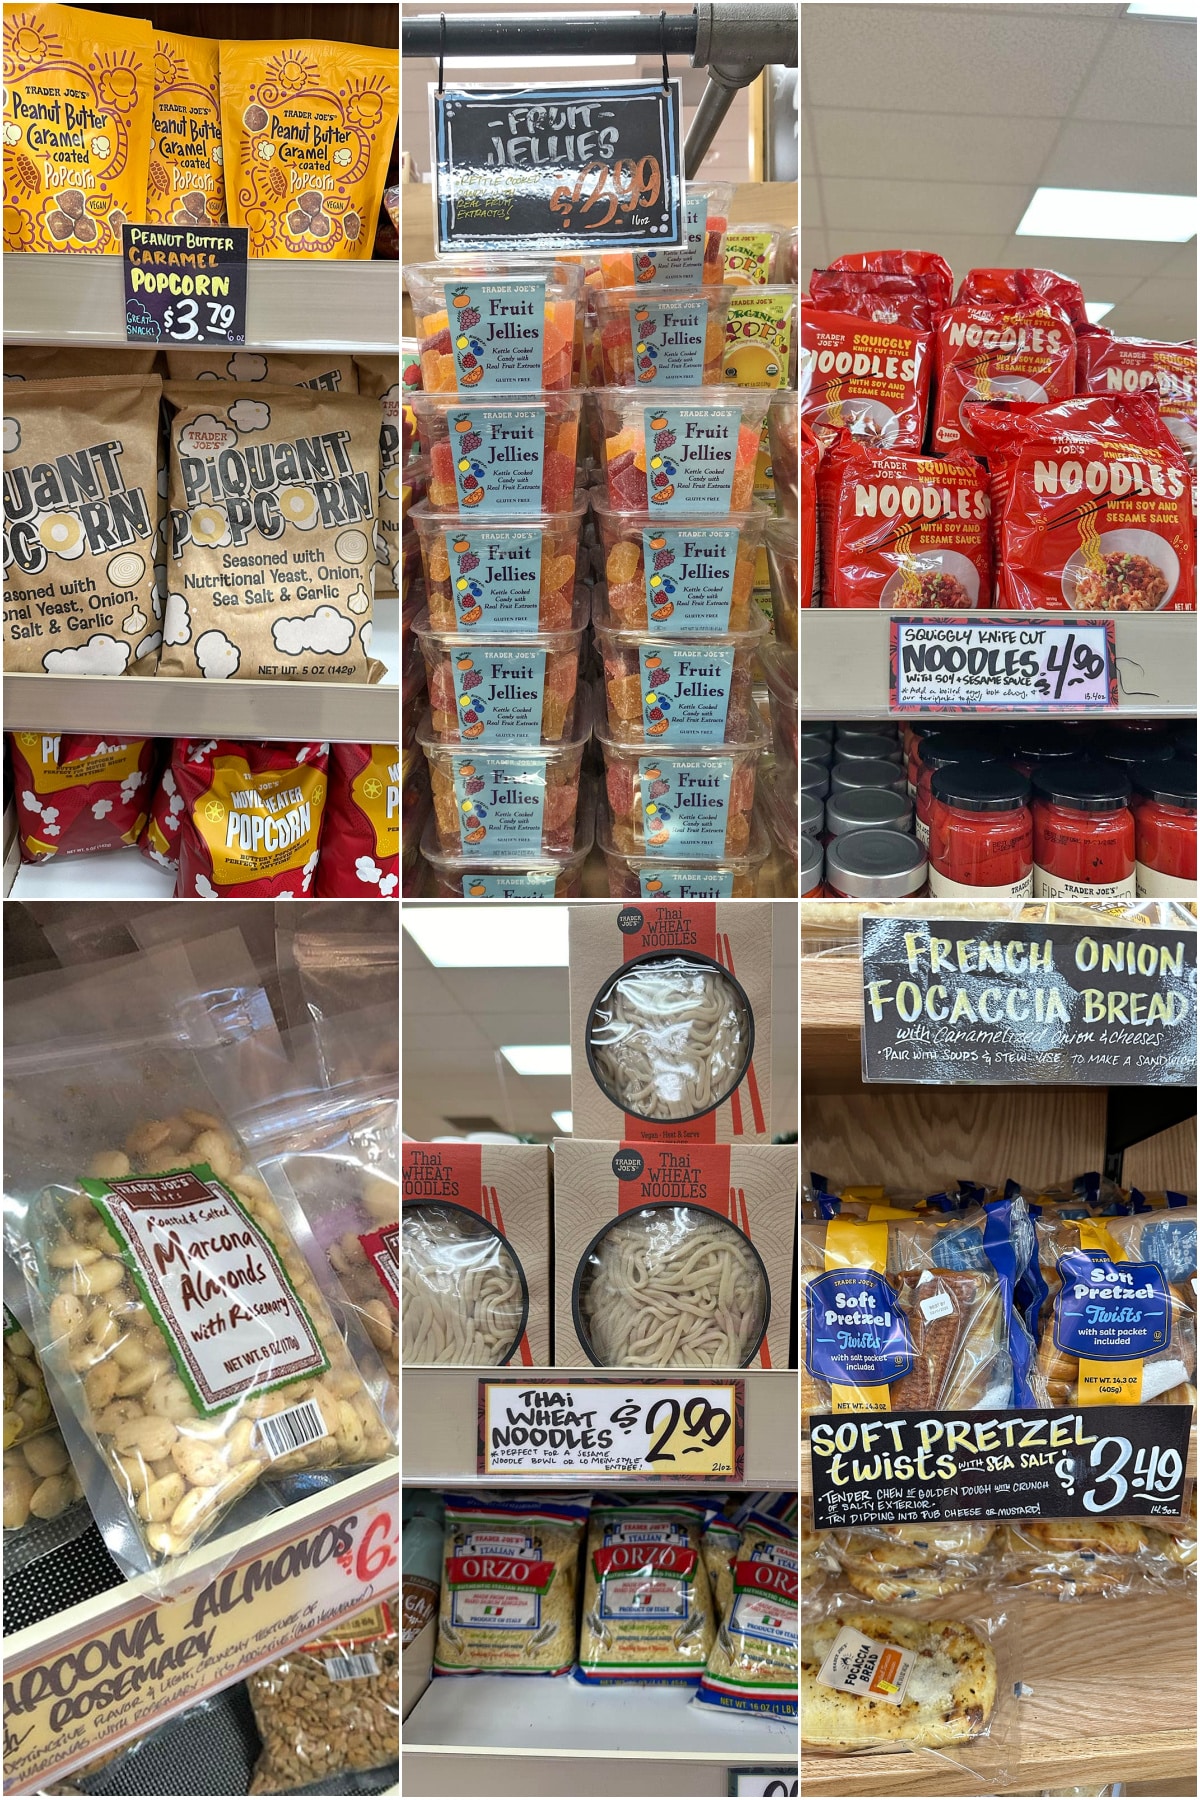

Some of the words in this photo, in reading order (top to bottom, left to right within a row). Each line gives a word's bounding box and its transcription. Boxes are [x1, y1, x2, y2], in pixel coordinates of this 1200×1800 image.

[25, 86, 60, 96] TRADER
[64, 88, 88, 99] JOE'S
[12, 91, 60, 125] Peanut
[66, 103, 108, 131] Butter
[508, 104, 602, 135] FRUIT
[27, 122, 85, 151] Caramel
[271, 115, 309, 143] Peanut
[314, 125, 351, 147] Butter
[487, 126, 619, 165] JELLIES
[53, 150, 89, 163] coated
[461, 175, 502, 187] KETTLE
[505, 175, 540, 186] COOKED
[89, 200, 107, 210] VEGAN
[131, 228, 184, 247] PEANUT
[186, 232, 234, 251] BUTTER
[129, 246, 219, 269] CARAMEL
[131, 268, 230, 297] POPCORN
[514, 285, 536, 293] JOE'S
[489, 299, 534, 316] Fruit
[126, 312, 150, 324] GREAT
[126, 324, 155, 336] SNACK!
[487, 322, 539, 341] Jellies
[512, 346, 533, 354] Cooked
[188, 431, 228, 442] TRADER
[685, 422, 729, 439] Fruit
[192, 440, 221, 450] JOE'S
[680, 444, 732, 462] Jellies
[872, 460, 907, 470] TRADER
[916, 461, 978, 478] SQUIGGLY
[875, 470, 902, 479] JOE'S
[919, 476, 941, 485] KNIFE
[943, 477, 956, 485] CUT
[958, 478, 979, 487] STYLE
[1034, 460, 1184, 497] NOODLES
[855, 484, 987, 520] NOODLES
[1107, 501, 1133, 510] WITH
[1136, 501, 1155, 510] SOY
[1158, 502, 1178, 511] AND
[1106, 513, 1147, 523] SESAME
[1150, 514, 1179, 523] SAUCE
[921, 523, 943, 532] WITH
[945, 523, 960, 532] SOY
[962, 524, 980, 532] AND
[920, 535, 953, 544] SESAME
[955, 535, 982, 544] SAUCE
[683, 542, 727, 558] Fruit
[222, 553, 288, 569] Seasoned
[293, 549, 325, 564] with
[184, 573, 266, 589] Nutritional
[271, 571, 312, 586] Yeast,
[317, 566, 364, 582] Onion,
[679, 563, 730, 580] Jellies
[213, 591, 239, 607] Sea
[244, 589, 274, 604] Salt
[279, 588, 291, 602] &
[296, 585, 340, 601] Garlic
[1020, 631, 1046, 645] CUT
[902, 644, 1040, 678] NOODLES
[258, 665, 277, 676] NET
[279, 665, 299, 676] WT.
[302, 665, 309, 675] 5
[311, 665, 325, 675] OZ
[327, 664, 356, 676] (142g)
[935, 673, 955, 683] SOY
[963, 675, 1001, 686] SESAME
[1003, 676, 1032, 686] SAUCE
[226, 802, 311, 852] POPCORN
[904, 931, 1053, 975] FRENCH
[1075, 936, 1186, 977] ONION
[865, 979, 1072, 1024] FOCACCIA
[1080, 988, 1188, 1027] BREAD
[894, 1024, 931, 1045] with
[615, 1158, 641, 1167] TRADER
[659, 1152, 691, 1168] Thai
[617, 1165, 637, 1173] JOE'S
[648, 1168, 701, 1184] WHEAT
[117, 1181, 160, 1196] TRADER
[160, 1178, 189, 1191] JOE'S
[640, 1181, 708, 1198] NOODLES
[150, 1191, 182, 1203] Nuts
[147, 1214, 189, 1232] Roasted
[189, 1213, 197, 1225] &
[199, 1205, 231, 1222] Salted
[153, 1230, 256, 1275] Marcona
[180, 1255, 267, 1311] Almonds
[836, 1292, 876, 1309] Soft
[1074, 1284, 1154, 1300] Pretzel
[191, 1317, 226, 1343] with
[230, 1298, 289, 1327] Rosemary
[825, 1311, 891, 1327] Pretzel
[837, 1331, 881, 1349] Twists
[1094, 1337, 1130, 1345] included
[1117, 1328, 1147, 1337] packet
[223, 1359, 243, 1373] NET
[244, 1352, 261, 1367] WT.
[262, 1348, 269, 1359] 6
[270, 1343, 281, 1356] OZ
[281, 1339, 300, 1355] (170g)
[846, 1363, 875, 1371] included
[1099, 1386, 1122, 1394] (405g)
[506, 1407, 598, 1428] WHEAT
[492, 1426, 614, 1450] NOODLES
[811, 1419, 907, 1456] SOFT
[915, 1414, 1099, 1454] PRETZEL
[500, 1448, 539, 1457] PERFECT
[543, 1449, 559, 1457] FOR
[577, 1450, 611, 1458] SESAME
[531, 1457, 557, 1465] BOWL
[826, 1446, 957, 1486] twists
[986, 1455, 1015, 1472] SEA
[1020, 1451, 1058, 1468] SALT
[822, 1490, 872, 1504] TENDER
[877, 1488, 903, 1499] CHEW
[918, 1486, 958, 1498] GOLDEN
[961, 1484, 992, 1495] DOUGH
[851, 1512, 895, 1523] DIPPING
[479, 1547, 516, 1556] ITALIAN
[611, 1547, 676, 1567] ORZO
[184, 1515, 358, 1629] ALMONDS
[462, 1559, 530, 1581] ORZO
[844, 1644, 871, 1686] FOCACCIA
[860, 1653, 878, 1682] BREAD
[50, 1626, 217, 1732] ROSEMARY
